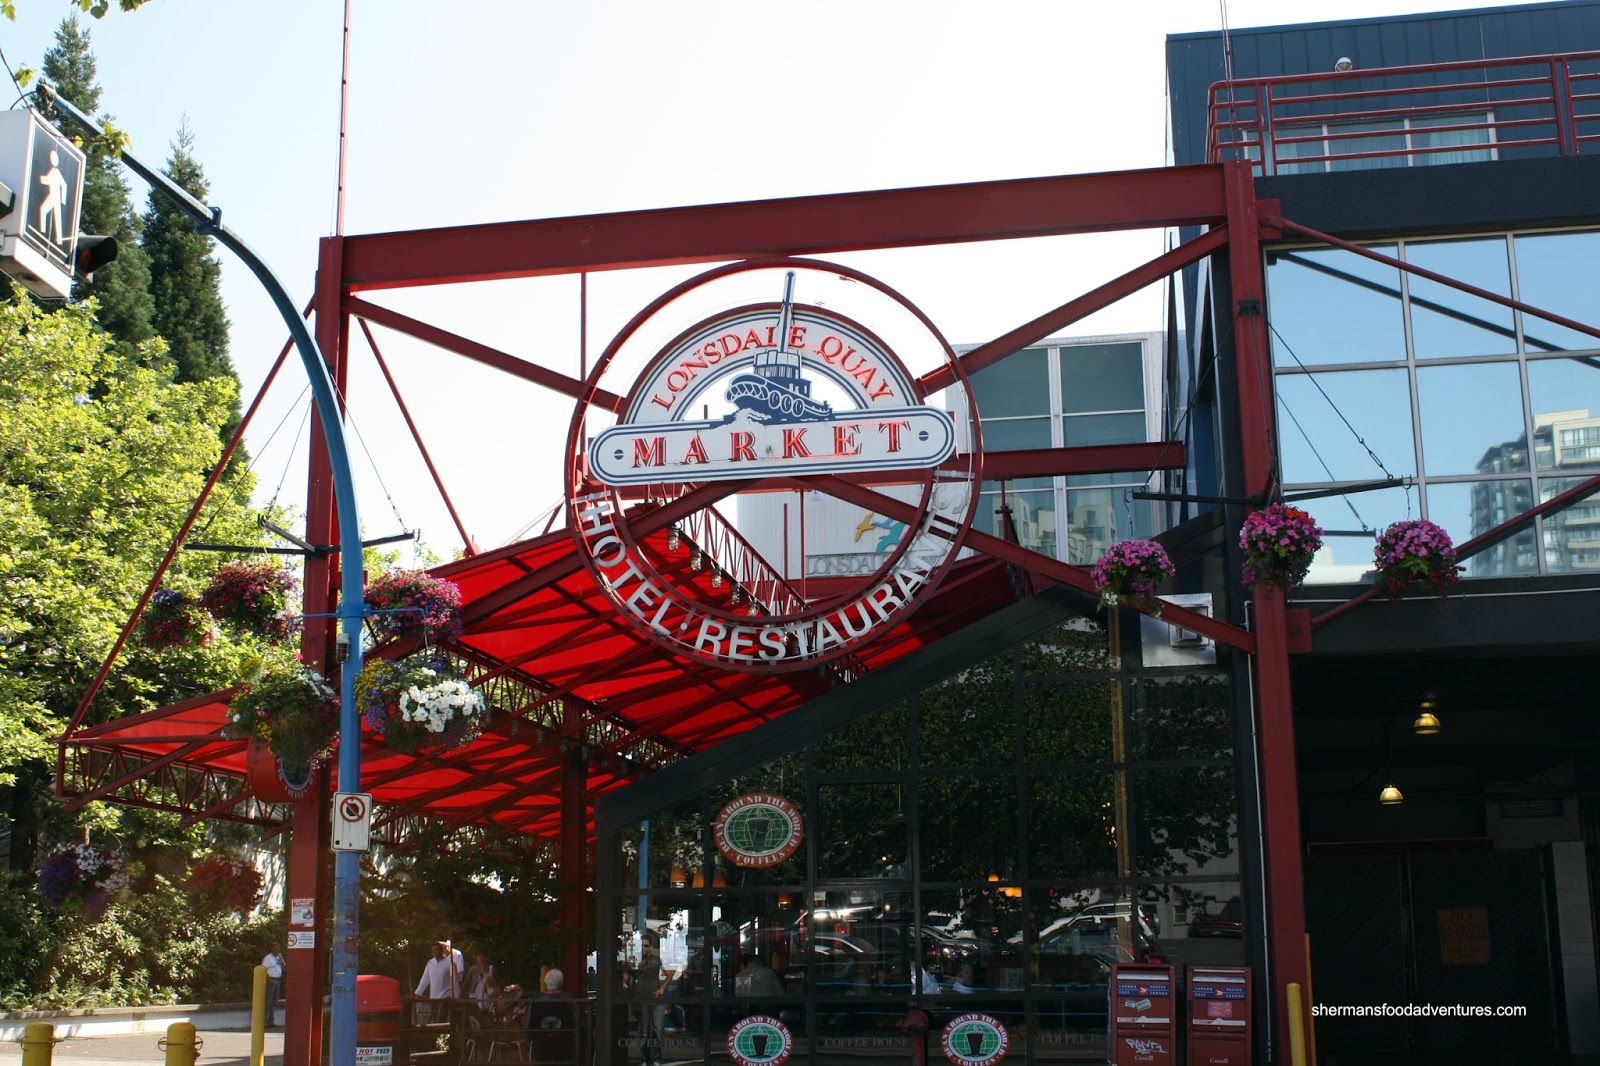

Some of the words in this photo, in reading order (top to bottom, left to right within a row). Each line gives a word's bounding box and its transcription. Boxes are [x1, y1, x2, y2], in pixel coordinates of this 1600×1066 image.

[651, 324, 807, 412] LONSDALE
[817, 334, 895, 402] QUAY
[630, 420, 912, 469] MARKET
[579, 498, 675, 637] HOTEL
[693, 484, 970, 662] RESTAURANTS
[720, 795, 762, 822] AROUND
[765, 795, 788, 810] THE
[716, 823, 730, 853] BEAN
[787, 808, 801, 847] WORLD
[735, 851, 786, 865] COFFEES
[732, 1016, 764, 1035] AROUND
[766, 1017, 782, 1030] THE
[945, 1014, 978, 1032] AROUND
[980, 1014, 998, 1027] THE
[617, 1037, 660, 1048] COFFEE
[664, 1037, 700, 1048] HOUSE
[728, 1035, 738, 1059] BEAN
[782, 1027, 792, 1058] WORLD
[824, 1036, 870, 1048] COFFEE
[872, 1036, 910, 1048] HOUSE
[942, 1034, 954, 1058] BEAN
[998, 1025, 1008, 1056] WORLD
[957, 1057, 996, 1066] COFFEES
